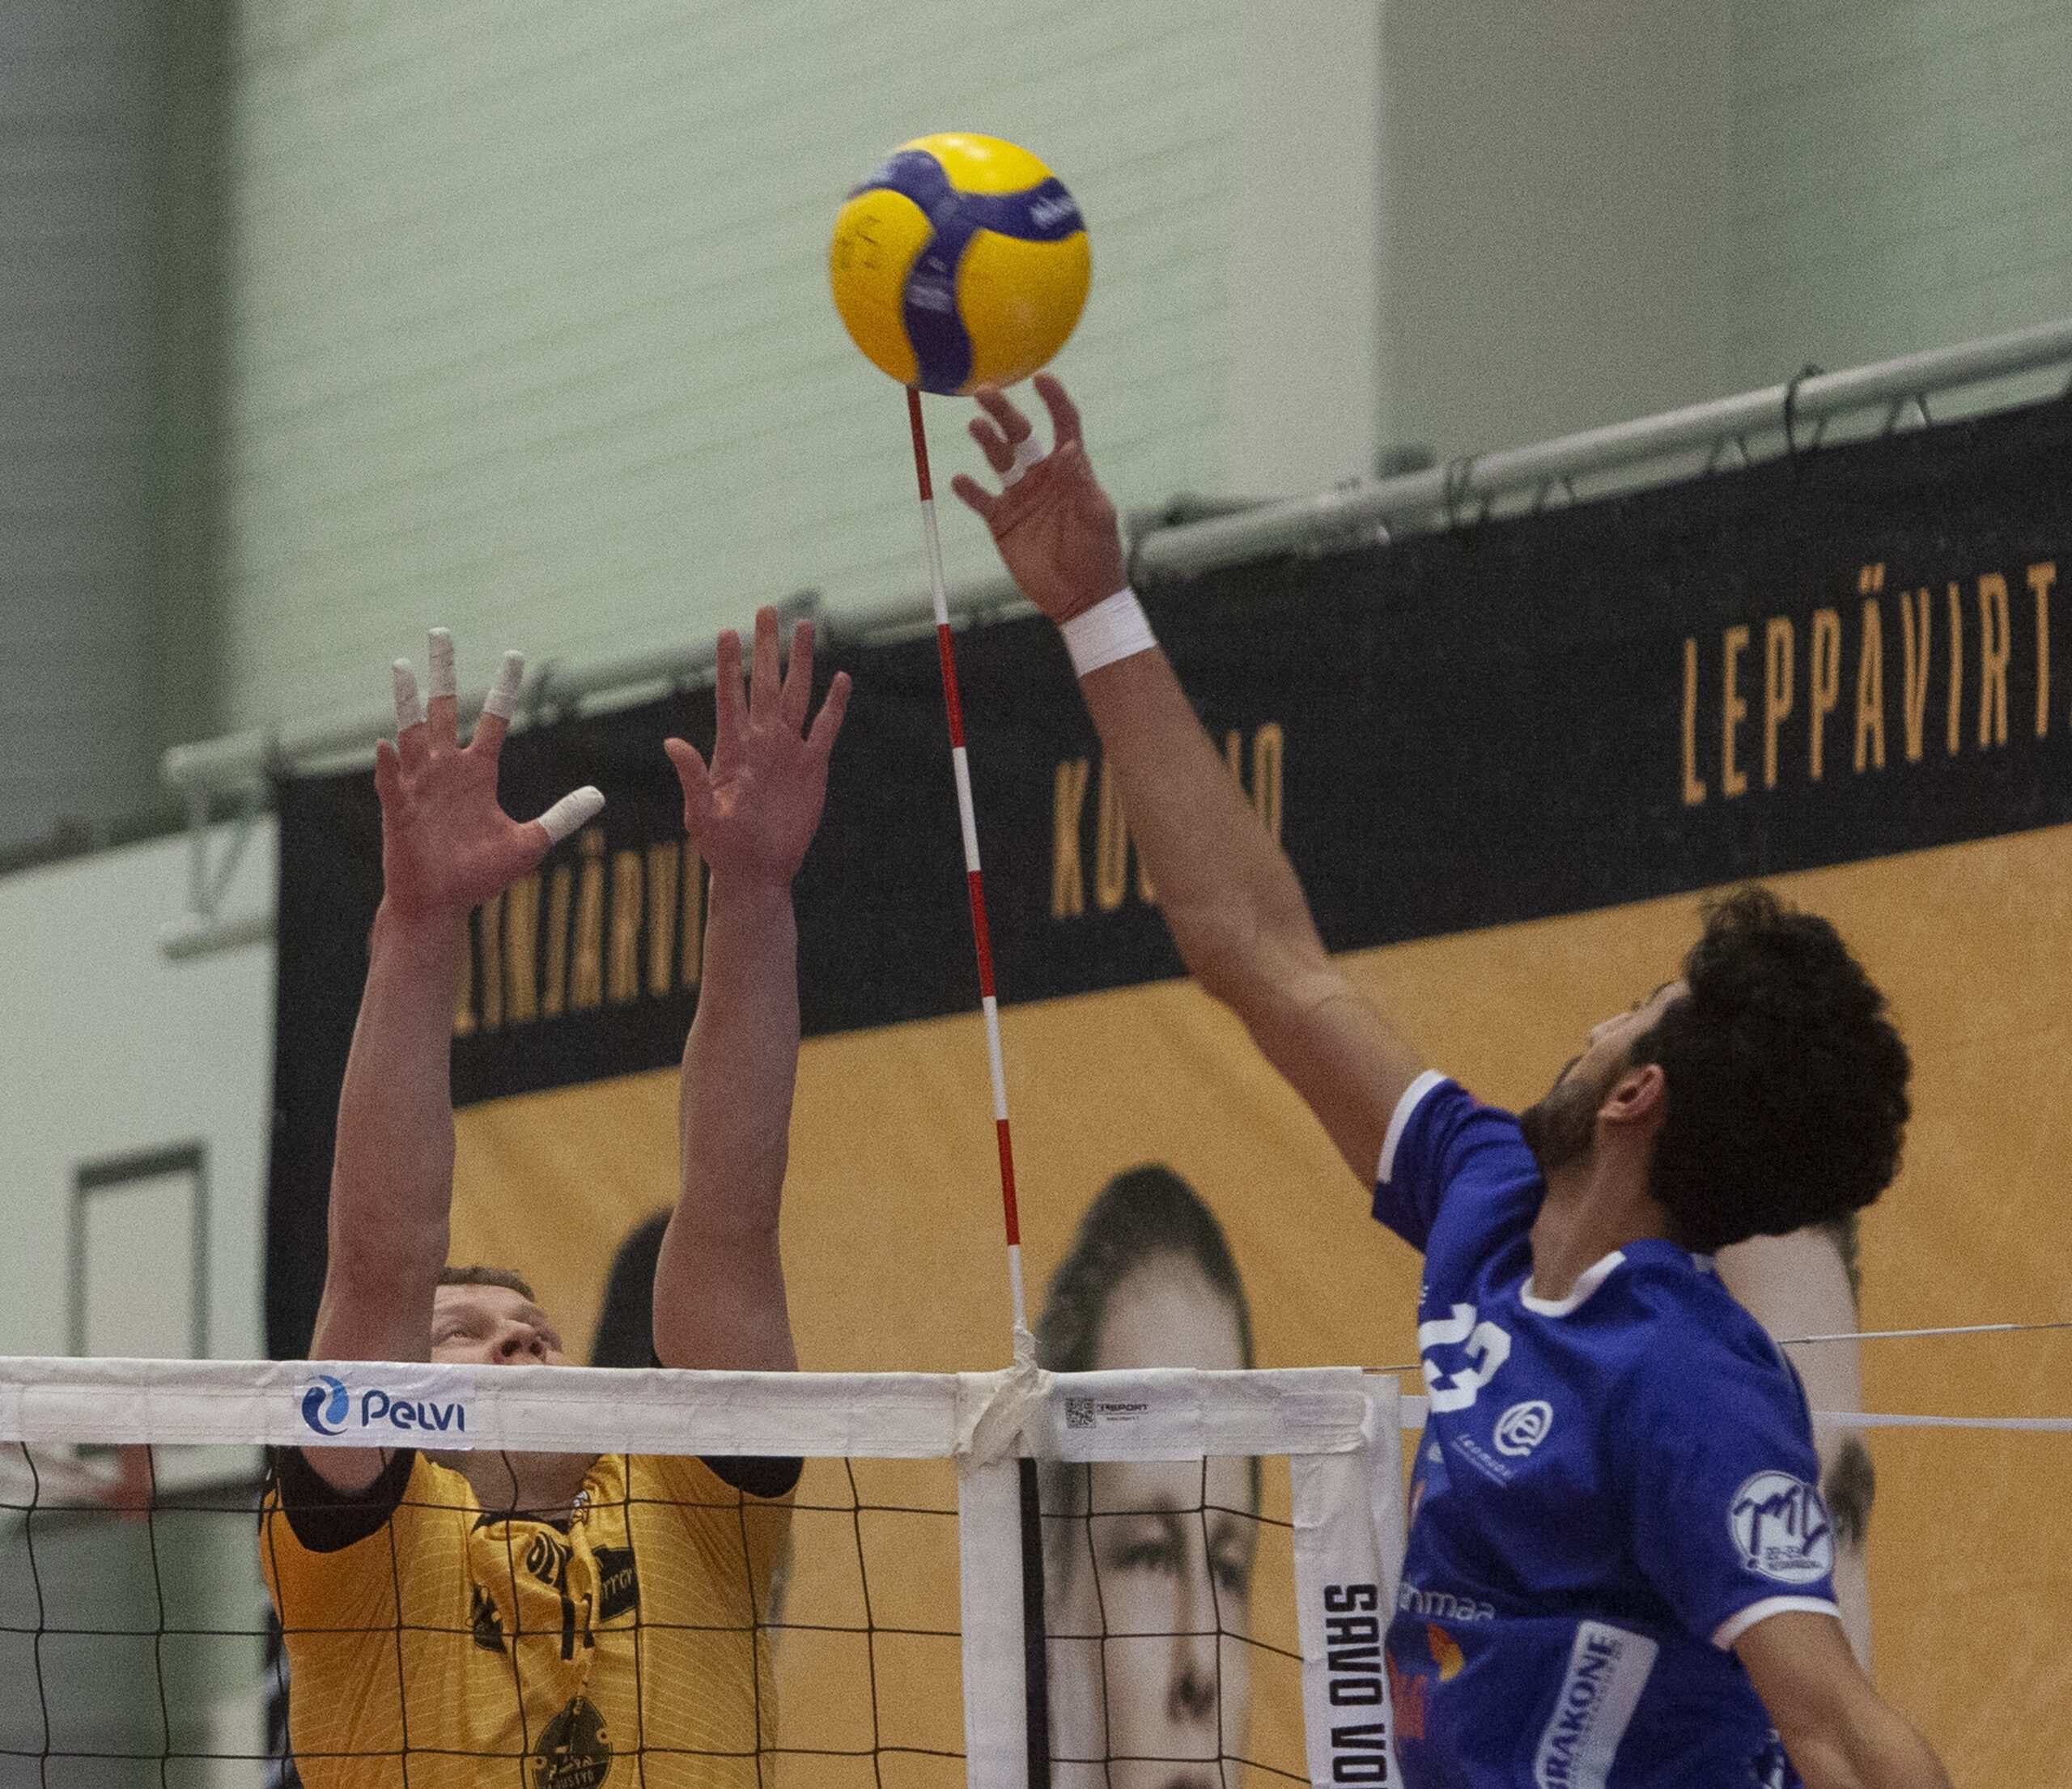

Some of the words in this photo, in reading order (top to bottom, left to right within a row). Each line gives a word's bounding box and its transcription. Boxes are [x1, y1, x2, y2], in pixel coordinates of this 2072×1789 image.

[1682, 561, 2072, 806] LEPPÄVIRT
[1323, 1583, 1383, 1707] SAVO
[1331, 1722, 1391, 1789] VO
